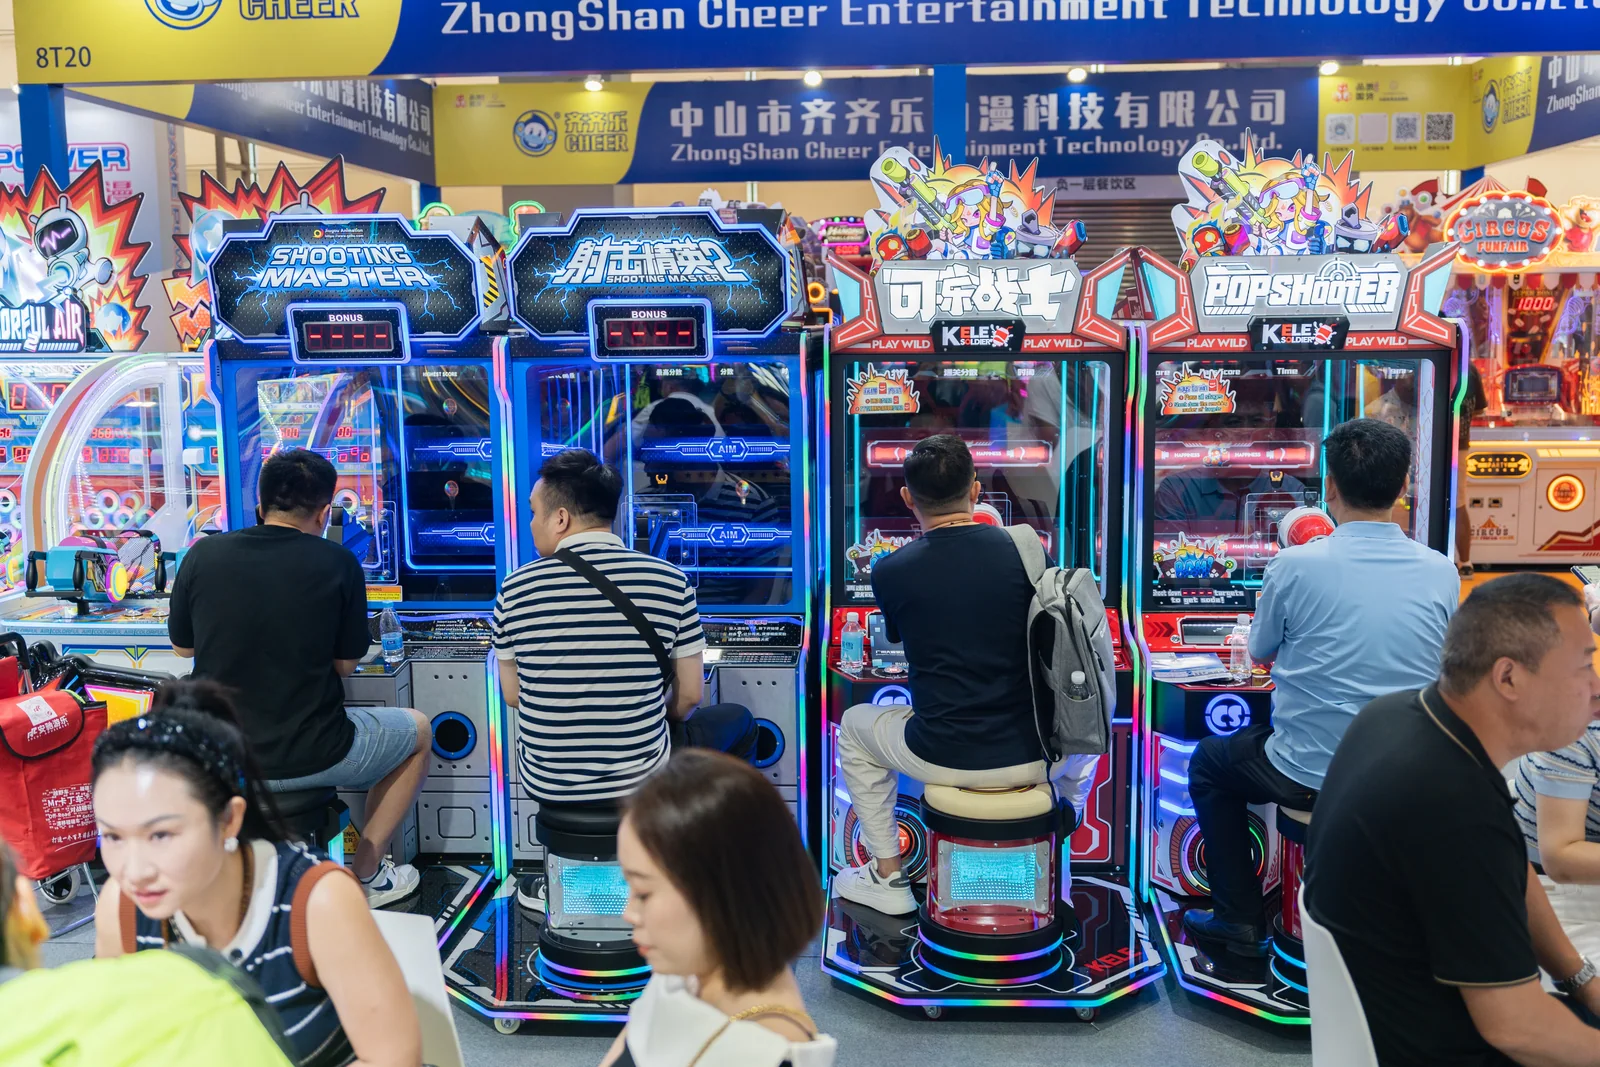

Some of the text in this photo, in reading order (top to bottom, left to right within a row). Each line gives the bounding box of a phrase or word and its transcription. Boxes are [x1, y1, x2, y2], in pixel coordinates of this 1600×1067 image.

[441, 0, 686, 42] ZhongShan
[698, 0, 828, 29] Cheer
[841, 0, 1169, 26] Entertainment
[35, 45, 92, 69] 8T20
[306, 99, 367, 136] Entertainment
[368, 119, 408, 152] Technology
[564, 110, 629, 134] 齐齐乐
[564, 133, 629, 153] CHEER
[671, 142, 799, 165] ZhongShan
[805, 141, 873, 160] Cheer
[1054, 136, 1190, 157] Technology
[1457, 219, 1551, 244] CIRCUS
[1477, 241, 1529, 253] FUNFAIR
[271, 246, 414, 266] SHOOTING
[259, 266, 431, 288] MASTER
[606, 274, 722, 284] SHOOTING MASTER
[1518, 297, 1555, 310] 1000
[329, 314, 363, 322] BONUS
[631, 310, 667, 318] BONUS
[872, 339, 930, 349] PLAY WILD
[1024, 338, 1083, 348] PLAY WILD
[1187, 338, 1247, 348] PLAY WILD
[1346, 337, 1407, 347] PLAY WILD
[1276, 368, 1299, 376] Time
[718, 444, 737, 454] AIM
[719, 530, 738, 539] AIM
[1214, 589, 1244, 598] targets
[1200, 596, 1225, 604] soda!
